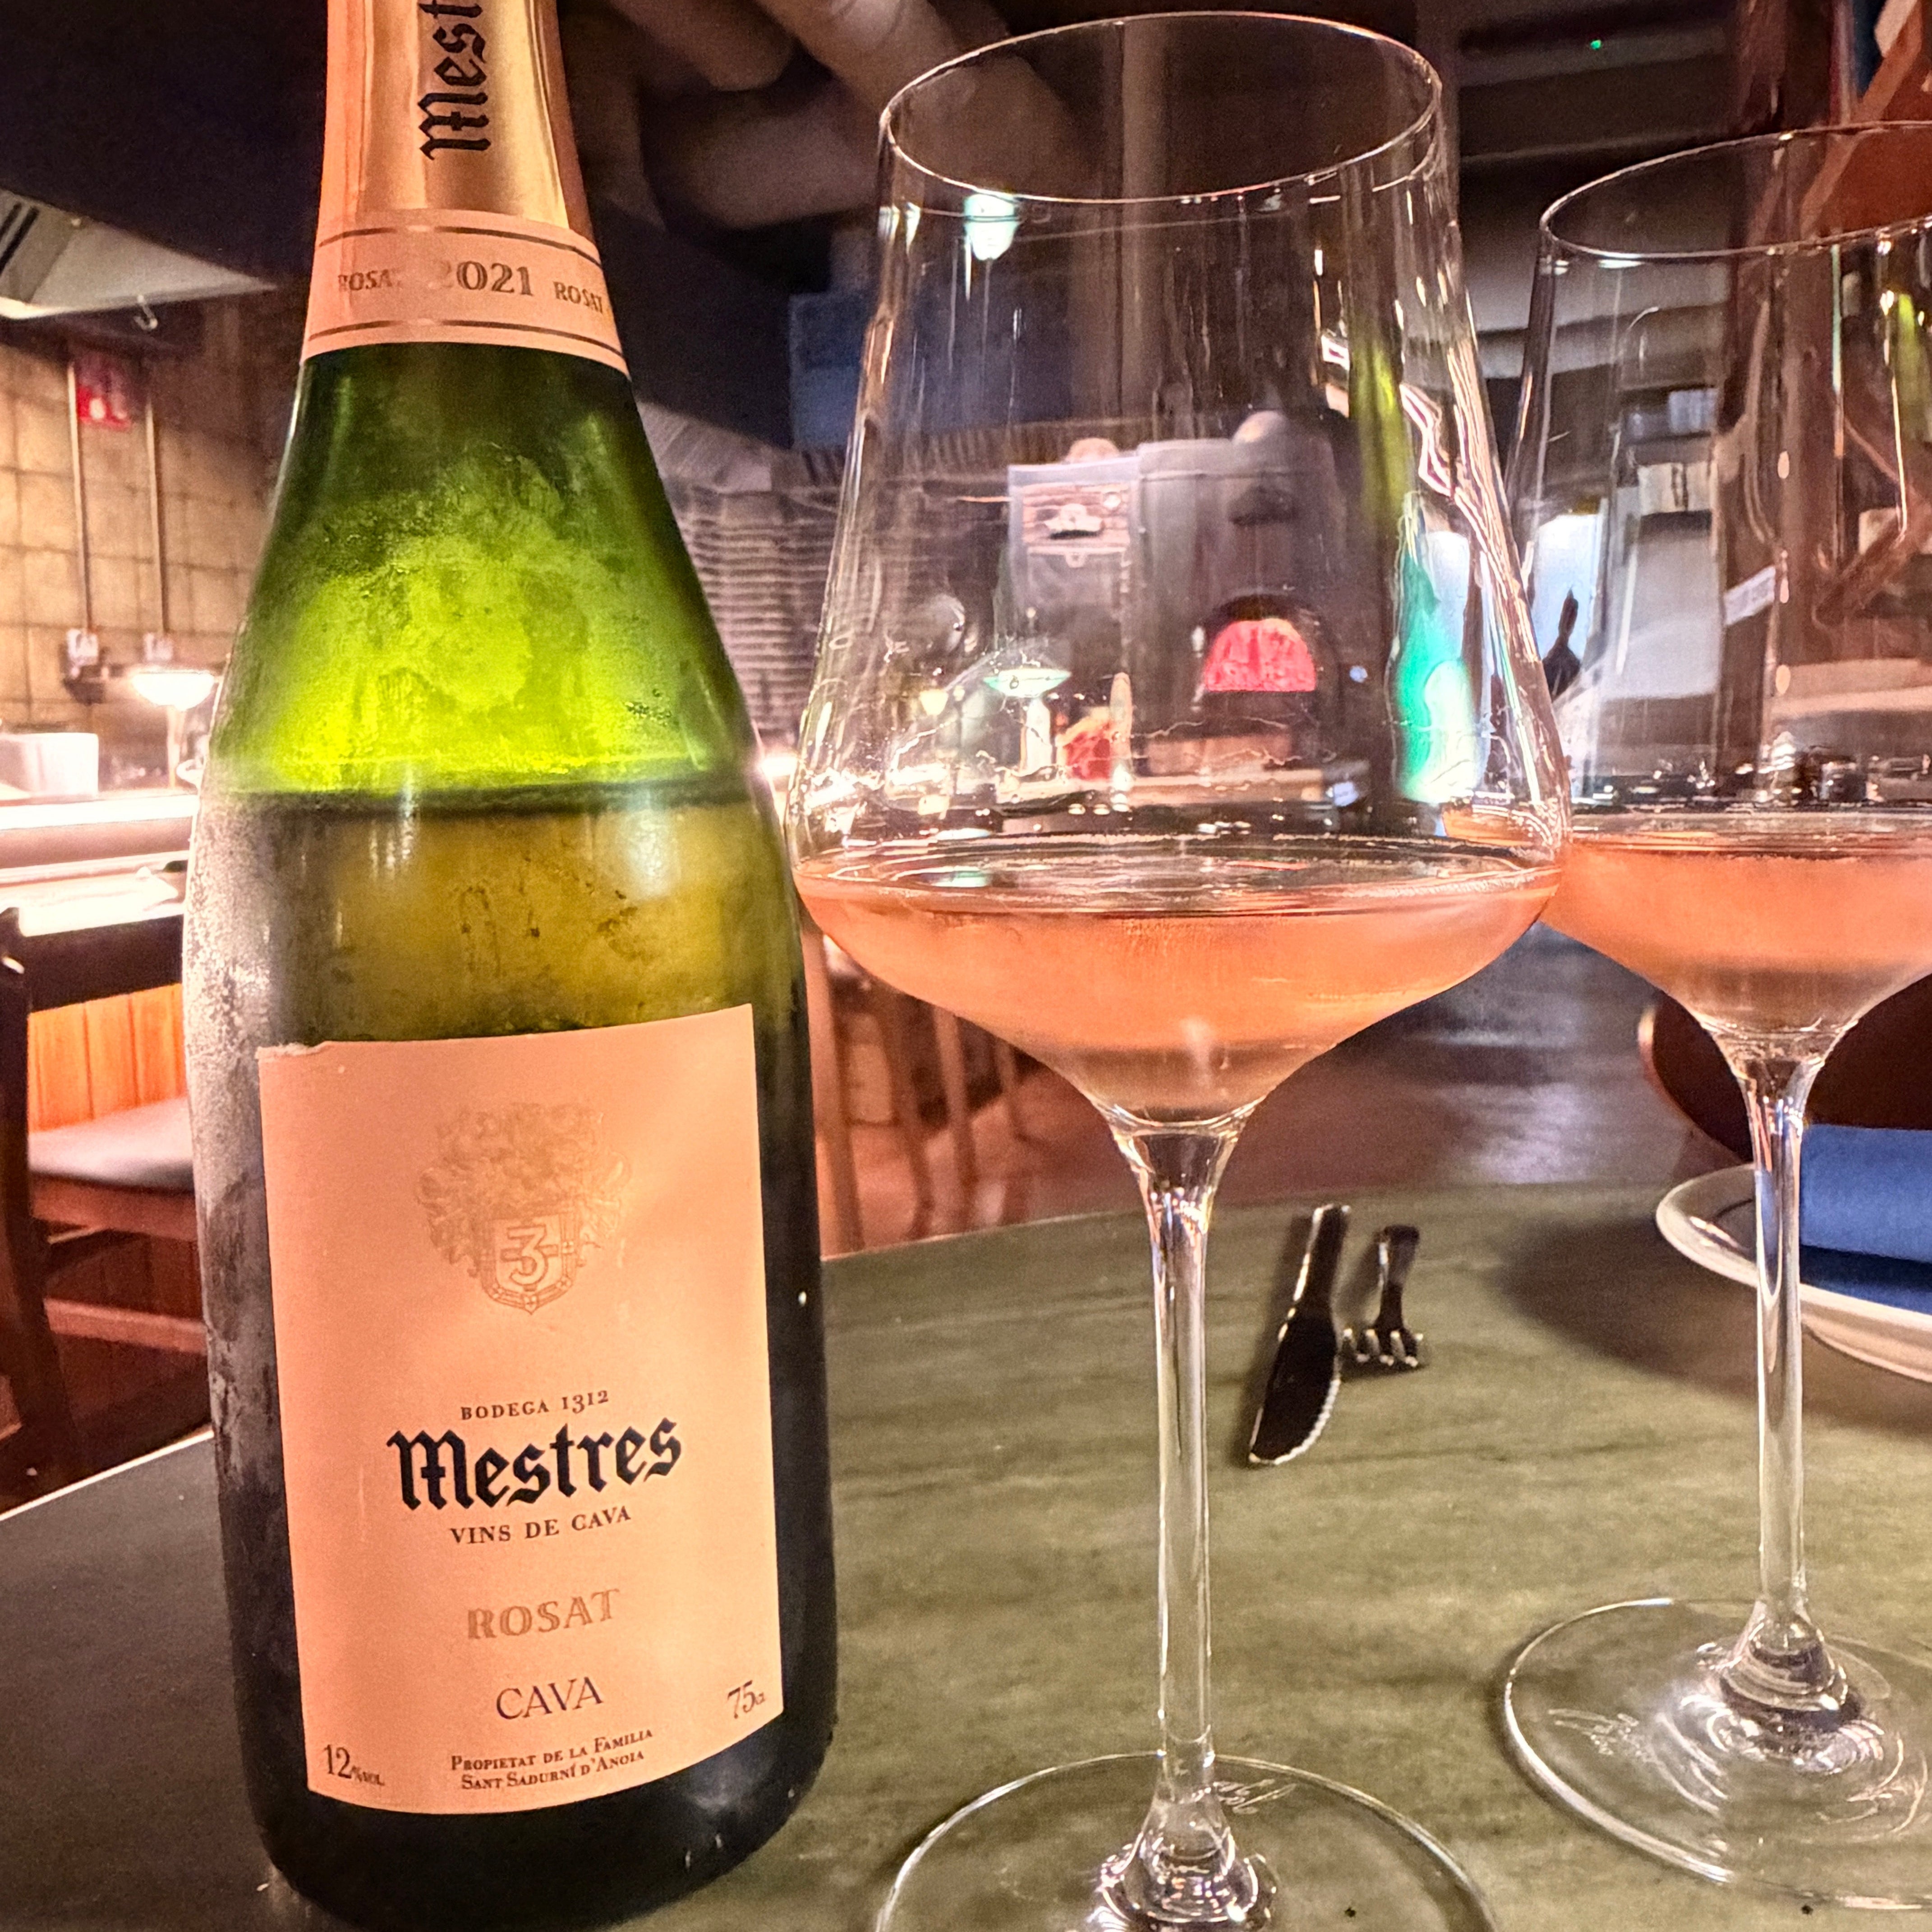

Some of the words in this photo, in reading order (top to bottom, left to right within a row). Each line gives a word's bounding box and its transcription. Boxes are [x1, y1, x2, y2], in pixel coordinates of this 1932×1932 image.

[553, 281, 603, 314] ROSAT
[460, 1400, 549, 1420] BODEGA
[562, 1390, 609, 1414] 1312
[386, 1417, 682, 1510] Mestres
[450, 1525, 511, 1544] VINS
[524, 1519, 560, 1539] DE
[571, 1505, 631, 1531] CAVA
[467, 1588, 620, 1640] ROSAT
[496, 1676, 603, 1720] CAVA
